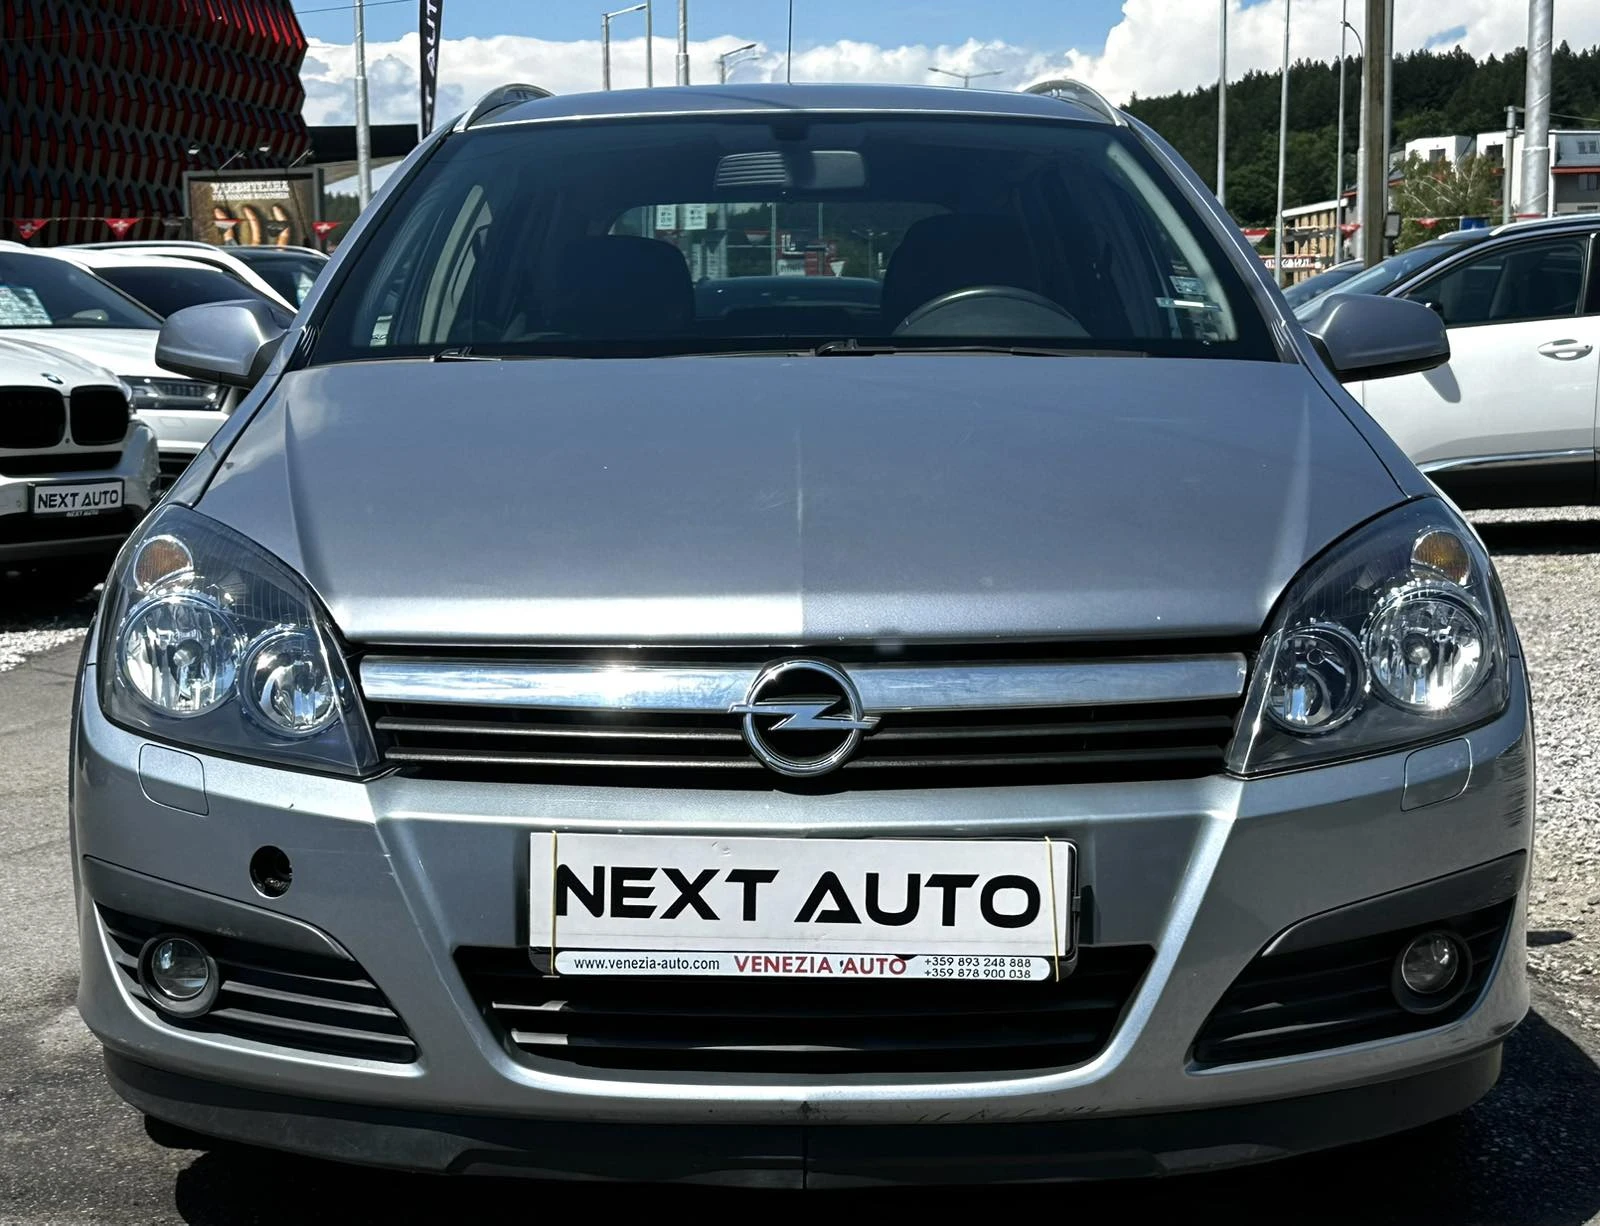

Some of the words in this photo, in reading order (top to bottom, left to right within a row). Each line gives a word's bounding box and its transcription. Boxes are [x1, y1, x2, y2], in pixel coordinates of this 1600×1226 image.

[38, 492, 80, 509] NEXT
[81, 489, 119, 507] AUTO
[556, 863, 780, 922] NEXT
[794, 870, 1041, 929] AUTO
[574, 956, 720, 971] www.venezia-auto.com
[734, 955, 833, 974] VENEZIA
[842, 957, 907, 975] AUTO
[924, 956, 954, 967] +359
[958, 957, 980, 967] 893
[984, 957, 1006, 968] 248
[1009, 958, 1032, 968] 888
[924, 967, 954, 978] +359
[957, 968, 980, 978] 878
[983, 969, 1006, 979] 900
[1009, 969, 1032, 979] 038
